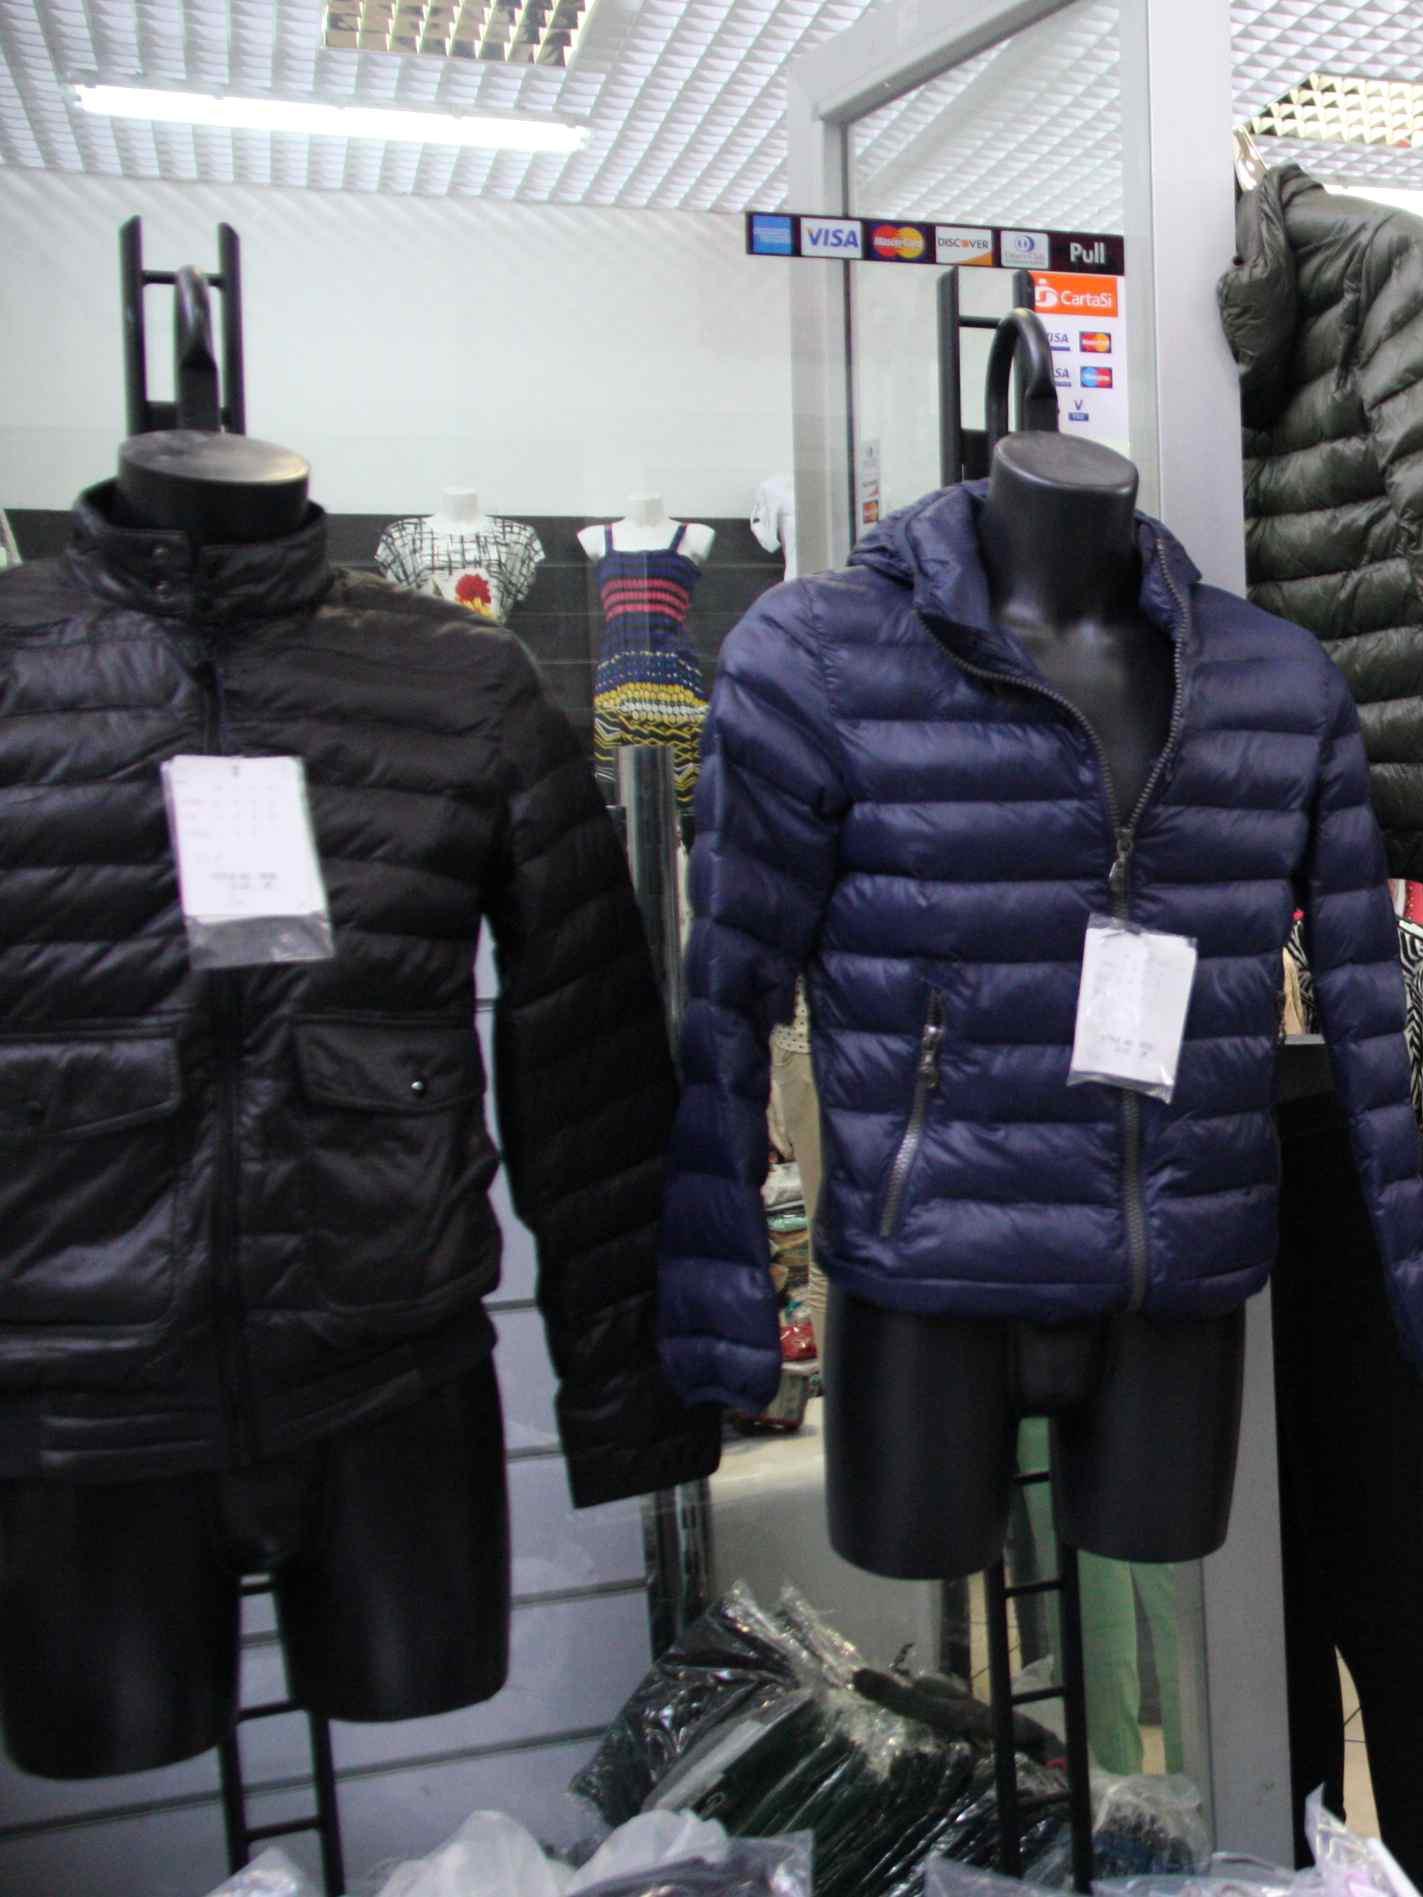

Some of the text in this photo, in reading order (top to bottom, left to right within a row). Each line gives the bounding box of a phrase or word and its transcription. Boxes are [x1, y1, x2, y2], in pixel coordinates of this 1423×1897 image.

[808, 227, 859, 248] VISA
[937, 237, 990, 249] DISCOVER
[1069, 242, 1106, 265] Pull
[1060, 290, 1112, 309] CartaSi
[1047, 332, 1070, 343] ISA
